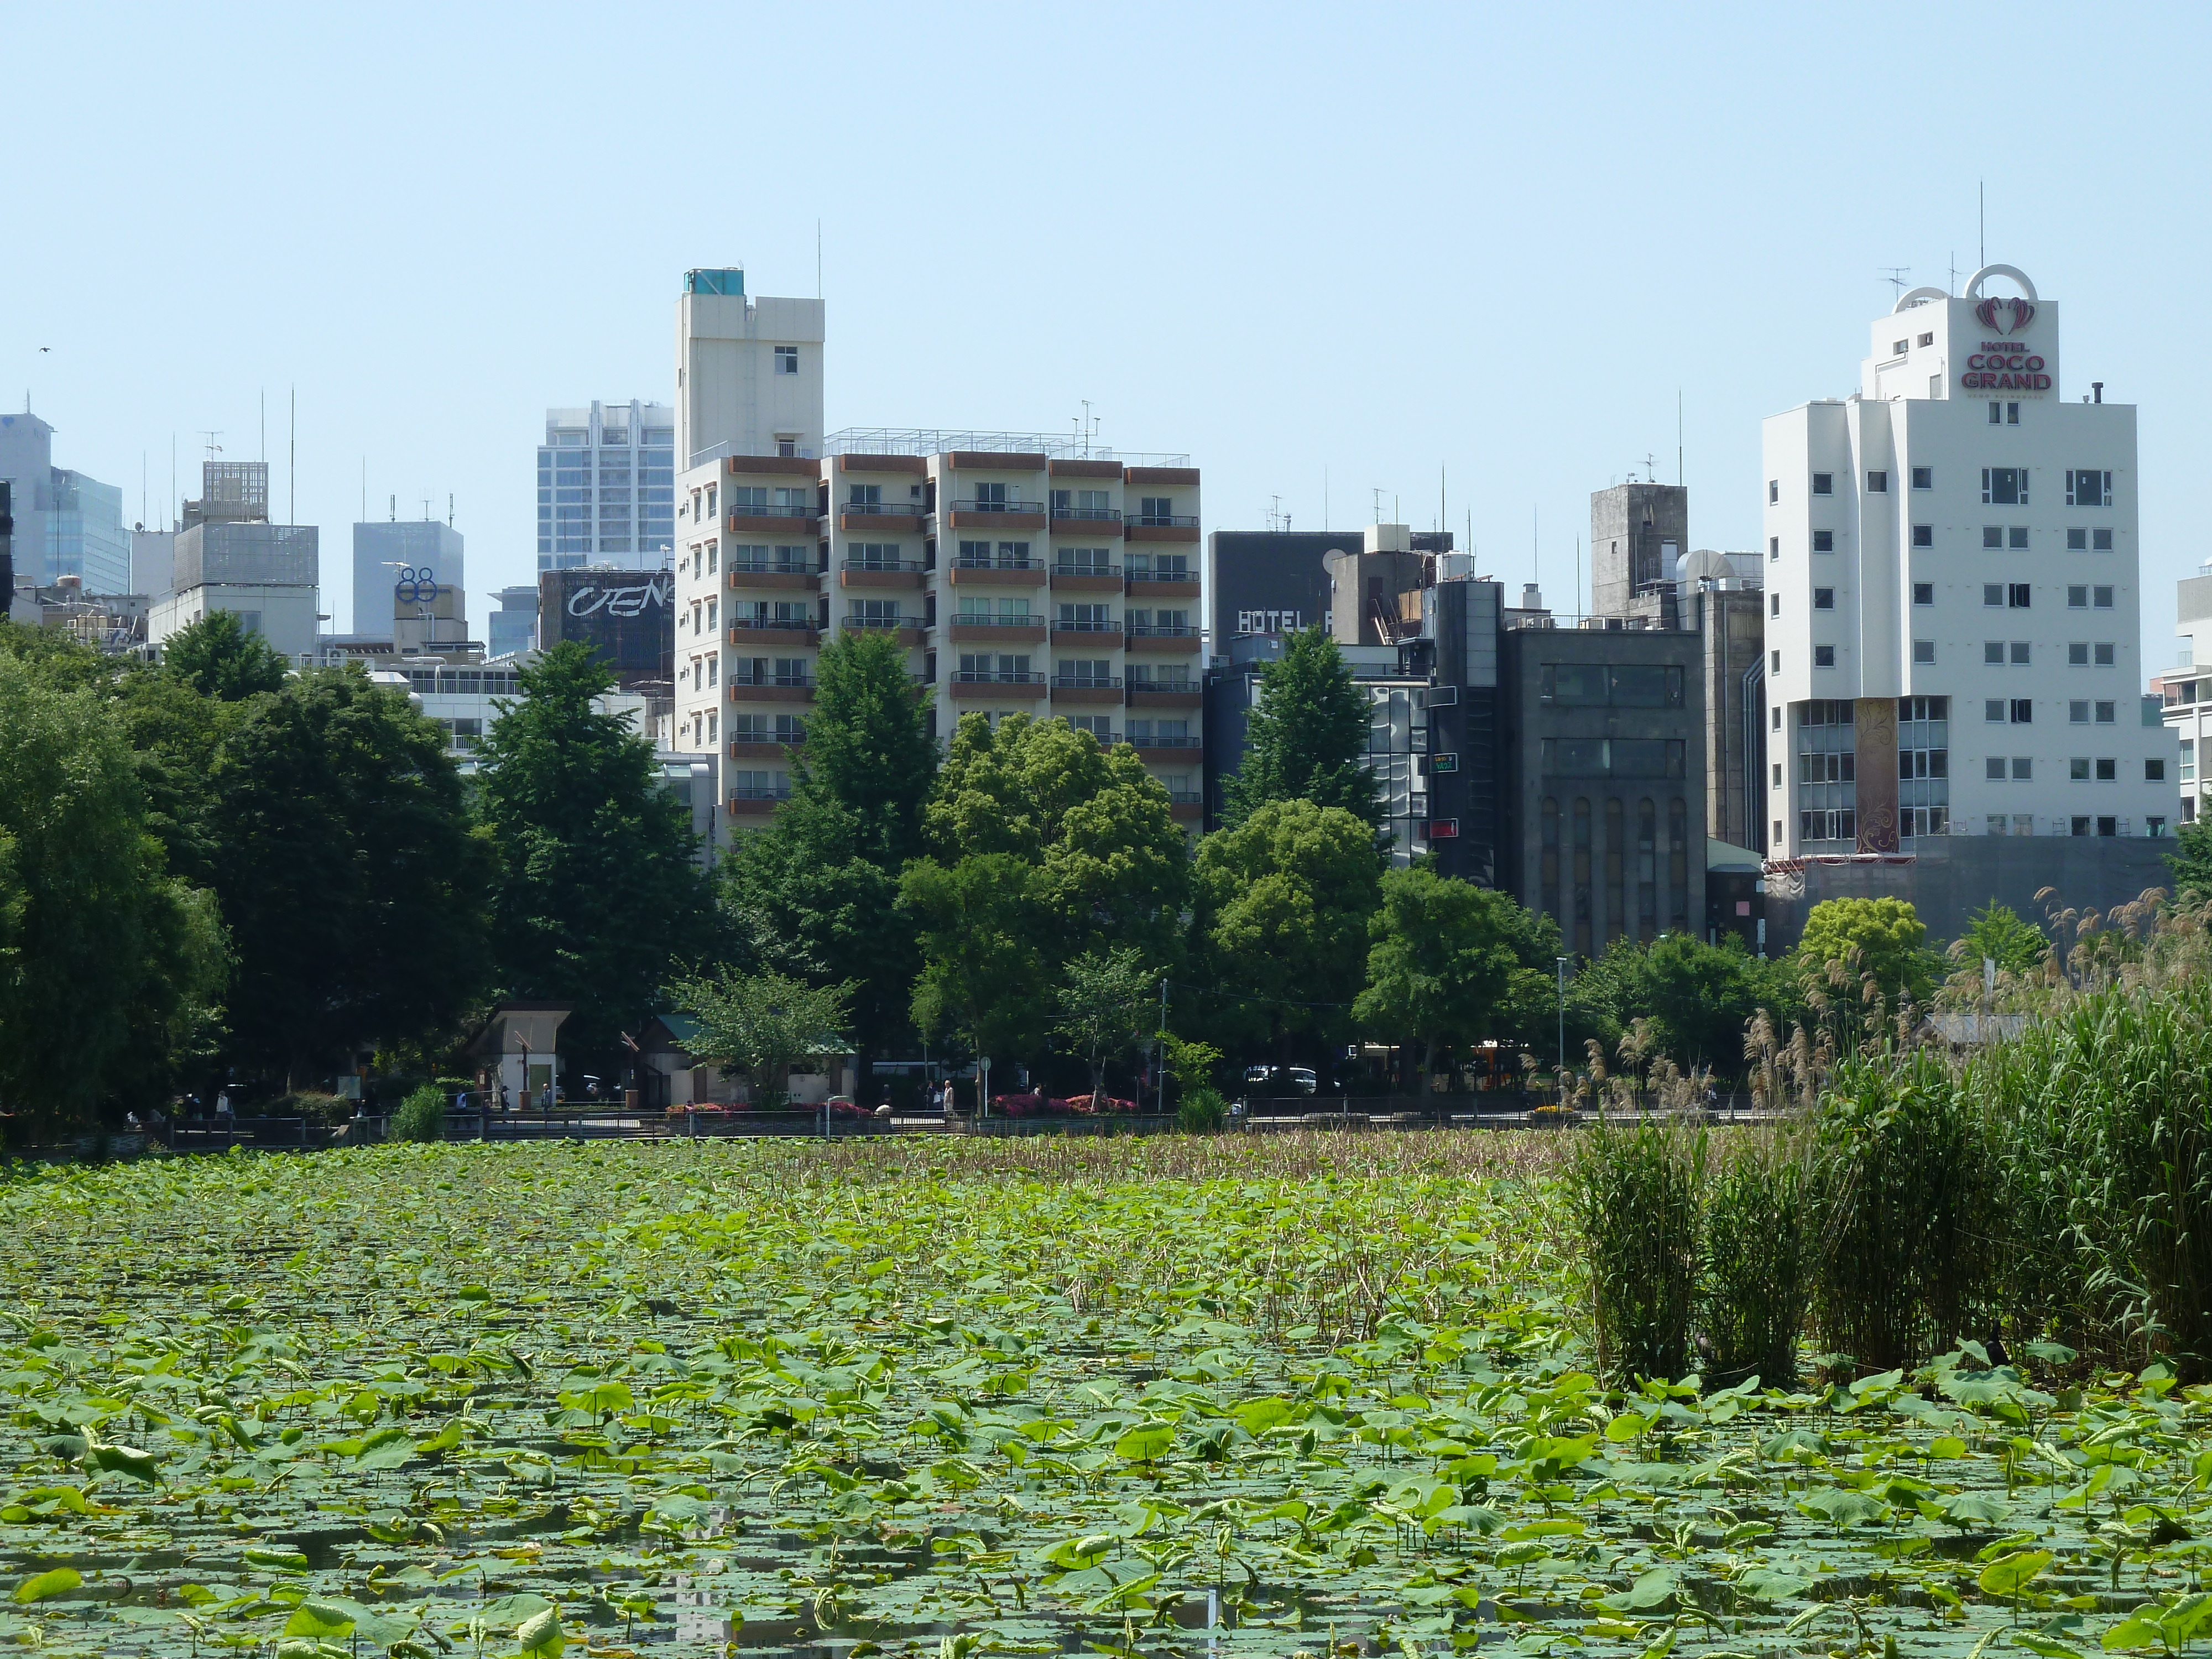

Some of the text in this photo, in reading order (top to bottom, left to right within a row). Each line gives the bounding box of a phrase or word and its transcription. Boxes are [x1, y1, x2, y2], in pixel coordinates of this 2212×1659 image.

[1981, 341, 2031, 352] HOTEL
[1967, 354, 2045, 372] COCO
[1961, 372, 2052, 390] GRAND
[1238, 611, 1308, 633] HOTEL
